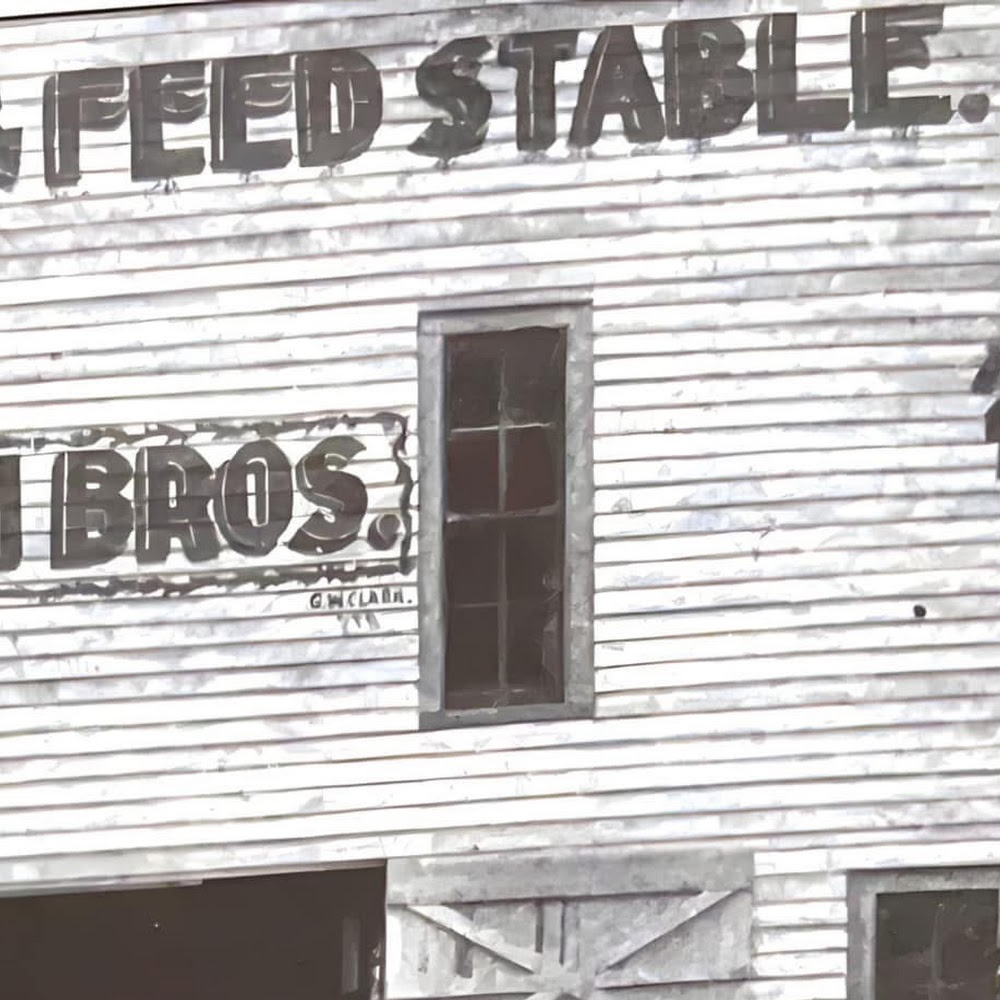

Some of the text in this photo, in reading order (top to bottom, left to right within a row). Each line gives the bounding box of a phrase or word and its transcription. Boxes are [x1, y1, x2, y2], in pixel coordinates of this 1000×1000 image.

[43, 50, 383, 187] FEED
[407, 5, 990, 158] STABLE.
[50, 437, 401, 569] BROS.
